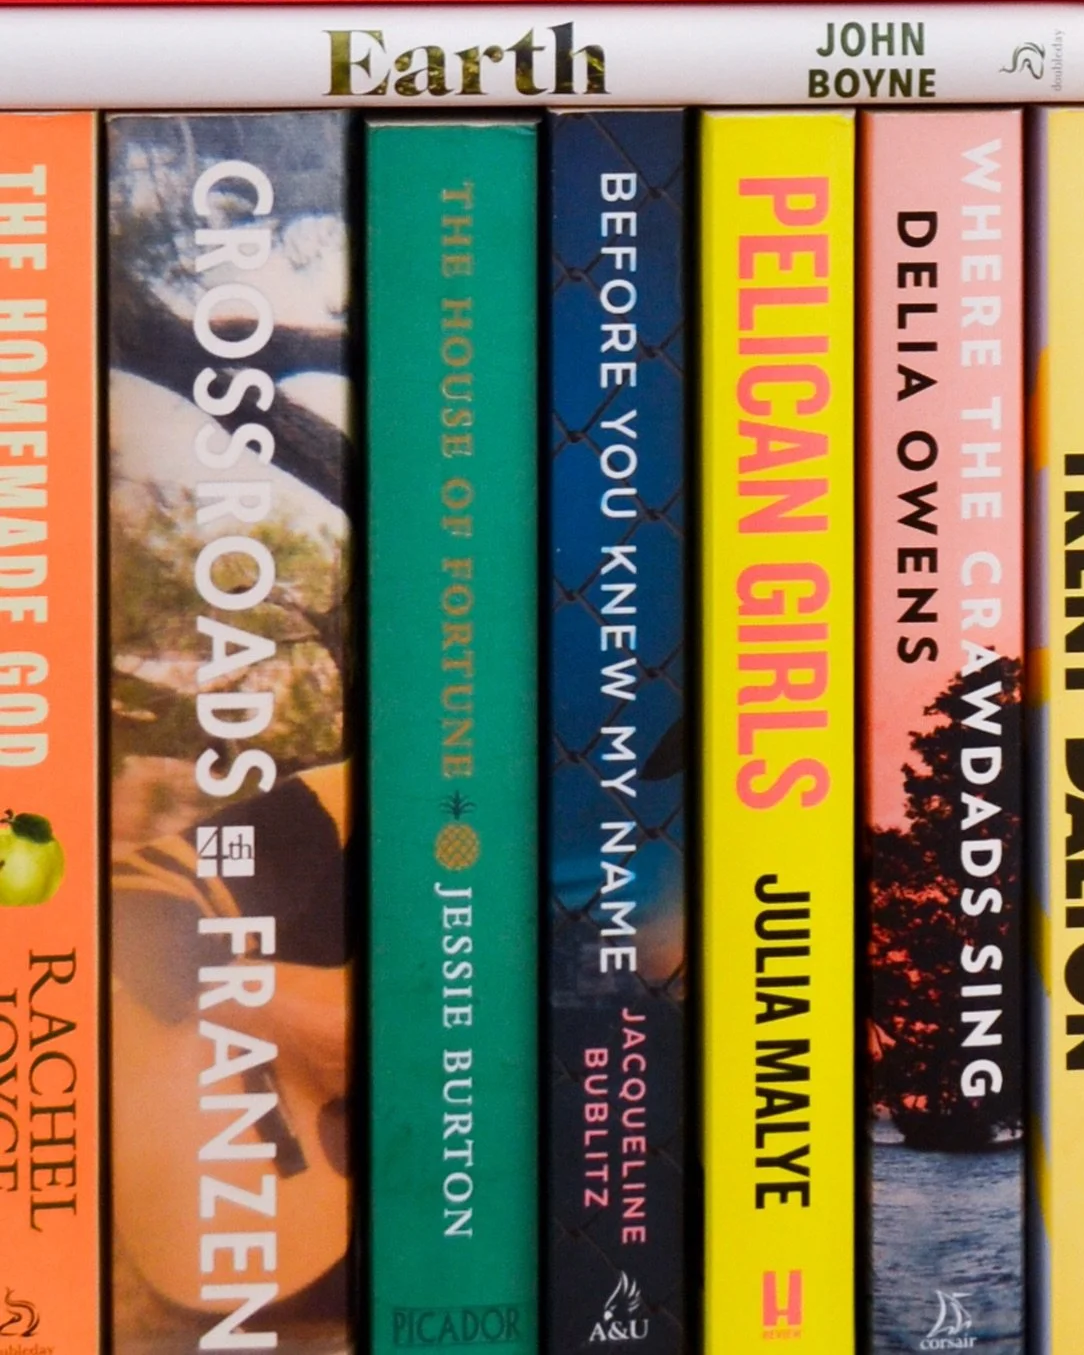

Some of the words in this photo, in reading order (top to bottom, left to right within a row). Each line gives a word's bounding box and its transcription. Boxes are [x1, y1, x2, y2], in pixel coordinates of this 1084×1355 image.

[323, 22, 611, 99] Earth
[807, 67, 937, 99] BOYNE
[815, 23, 926, 57] JOHN
[1051, 29, 1065, 92] doubleday
[0, 164, 47, 271] THE
[439, 181, 475, 277] THE
[599, 173, 638, 388] BEFORE
[960, 138, 1002, 368] WHERE
[440, 297, 475, 458] HOUSE
[736, 175, 831, 535] PELICAN
[896, 210, 938, 402] DELIA
[192, 159, 276, 797] CROSSROADS
[441, 476, 475, 539] OF
[599, 409, 638, 519] YOU
[960, 396, 1002, 521] THE
[599, 546, 638, 702] KNEW
[896, 430, 938, 665] OWENS
[0, 650, 50, 768] GOD
[441, 558, 475, 778] FORTUNE
[735, 561, 832, 810] GIRLS
[960, 551, 1003, 918] CRAWDADS
[600, 726, 637, 798] MY
[434, 883, 474, 1029] JESSIE
[600, 821, 637, 974] NAME
[754, 872, 811, 1025] JULIA
[28, 947, 77, 1234] RACHEL
[960, 944, 1003, 1099] SING
[198, 916, 279, 1351] FRANZEN
[442, 1049, 474, 1238] BURTON
[584, 1048, 609, 1208] BUBLITZ
[617, 1007, 647, 1245] JACQUELINE
[754, 1039, 811, 1210] MALYE
[392, 1307, 522, 1345] PICADOR
[588, 1319, 649, 1343] A&U
[919, 1334, 978, 1351] corsair
